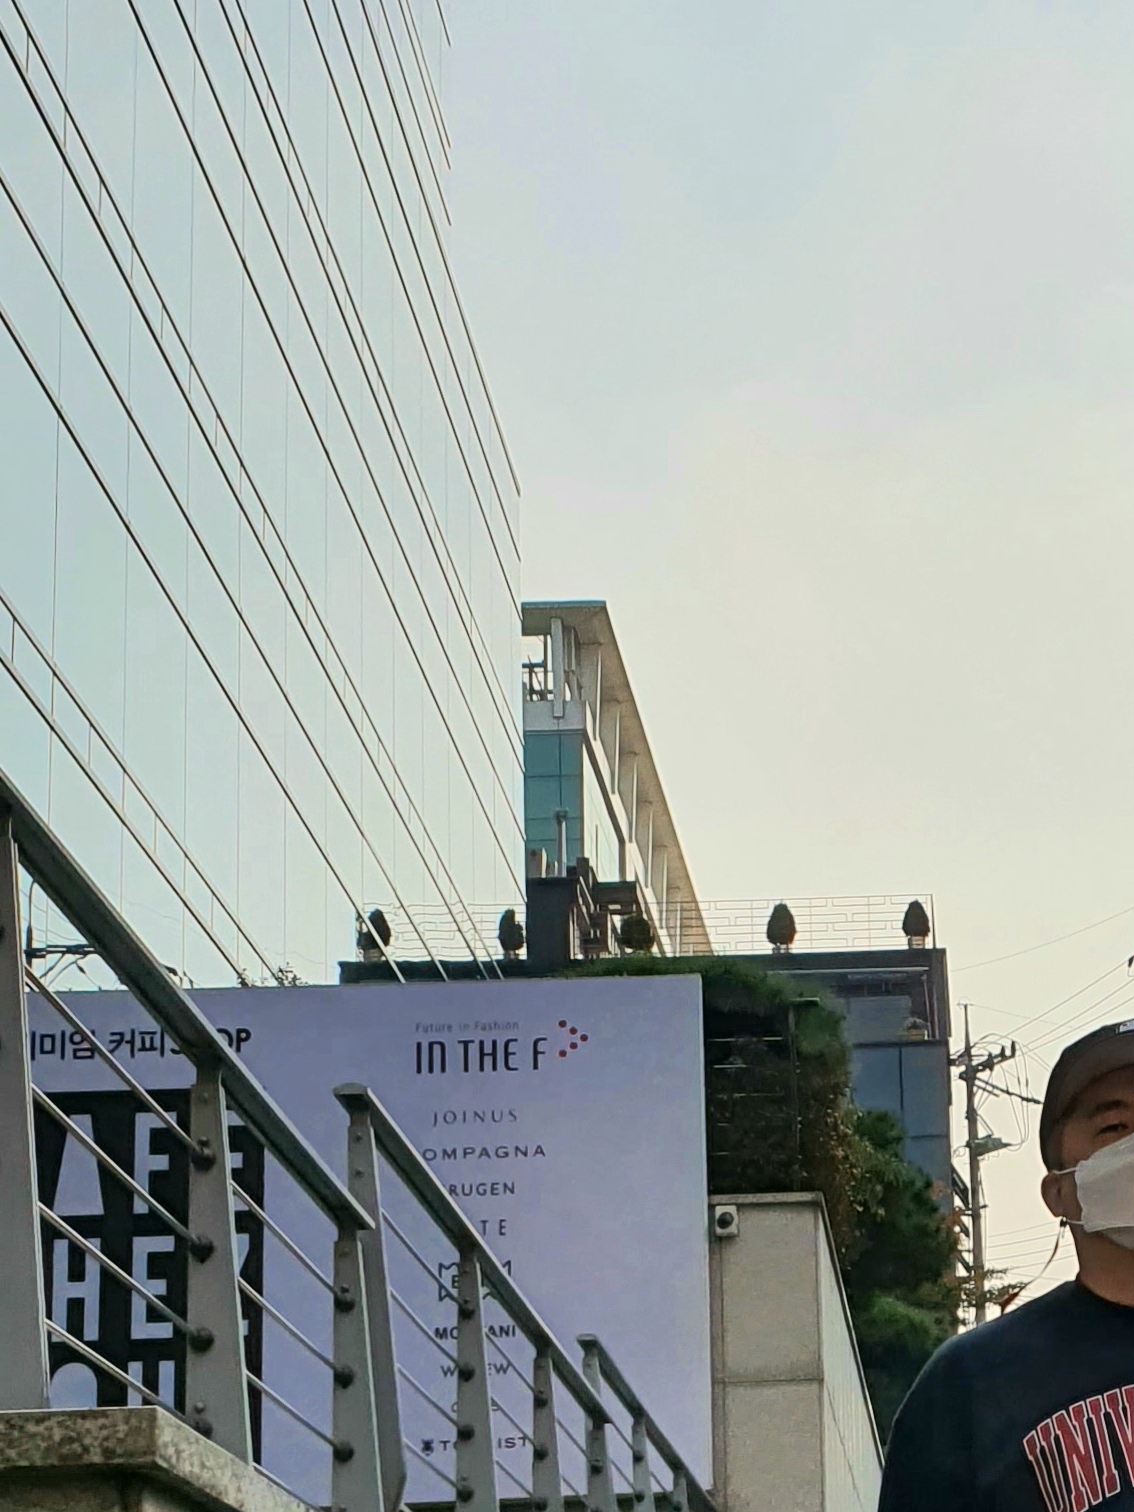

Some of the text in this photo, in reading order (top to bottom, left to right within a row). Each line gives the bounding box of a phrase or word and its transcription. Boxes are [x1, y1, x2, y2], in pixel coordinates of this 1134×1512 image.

[416, 1020, 520, 1034] Future in Fashion
[457, 1037, 519, 1073] THE
[532, 1037, 548, 1070] F
[432, 1109, 518, 1127] JOINUS
[422, 1144, 547, 1162] OMPAGNA
[449, 1181, 516, 1198] RUGEN
[480, 1218, 507, 1237] TE
